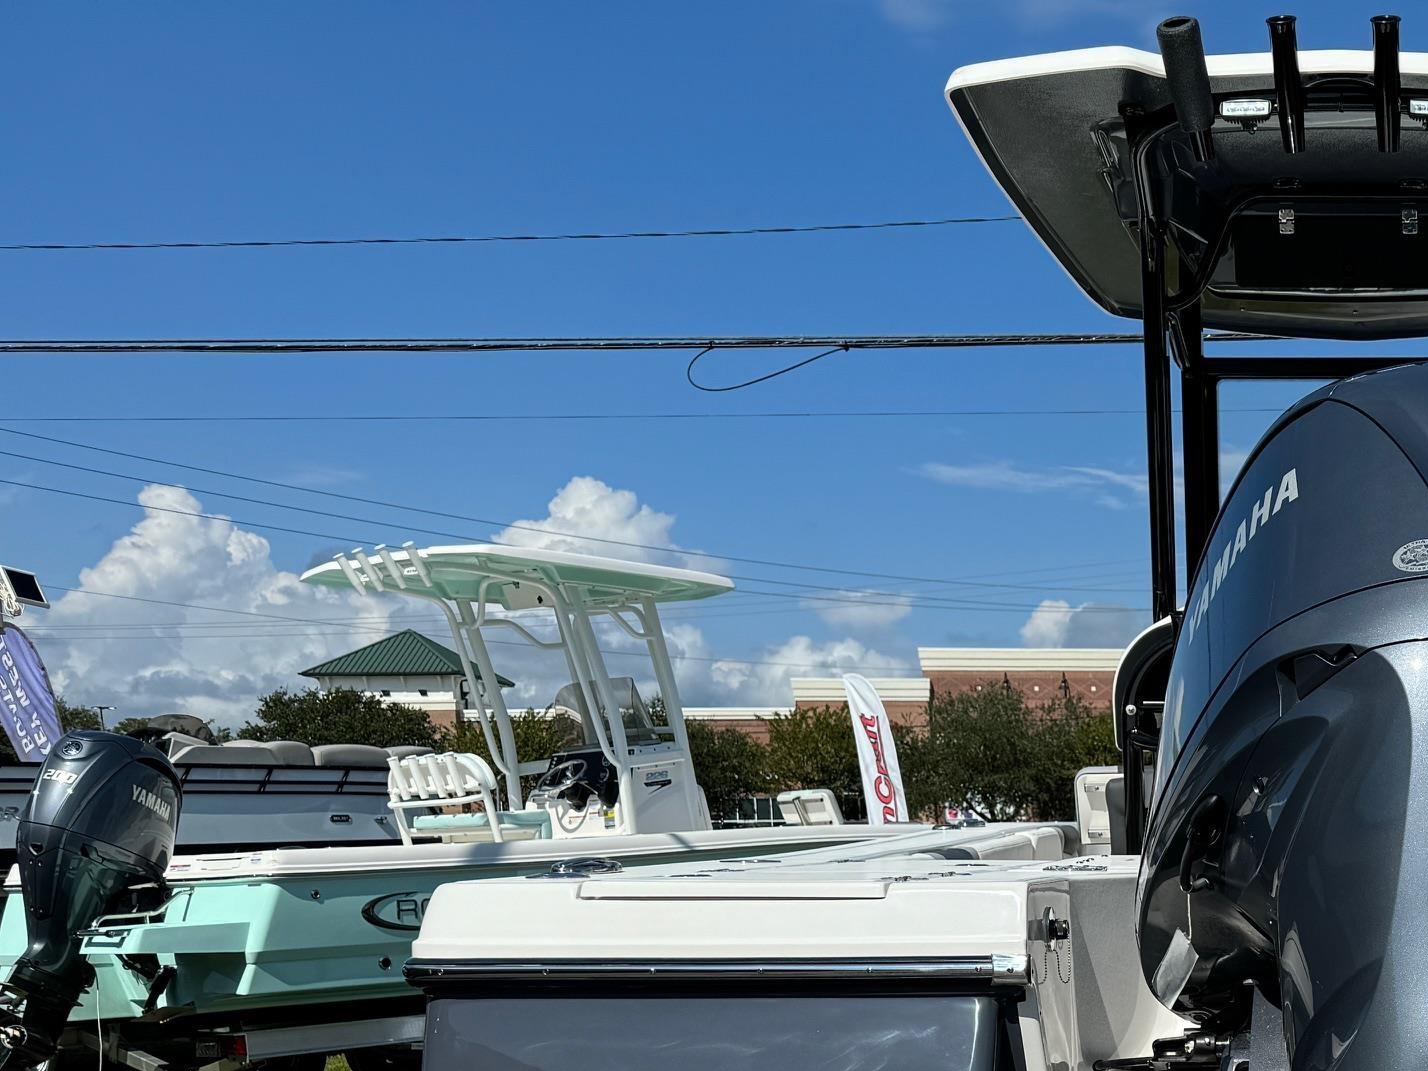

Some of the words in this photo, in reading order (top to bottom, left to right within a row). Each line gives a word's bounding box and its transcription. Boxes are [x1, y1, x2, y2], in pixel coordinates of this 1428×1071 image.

[1188, 467, 1299, 646] YAMAHA
[43, 768, 78, 785] 200
[132, 784, 171, 820] YAMAHA
